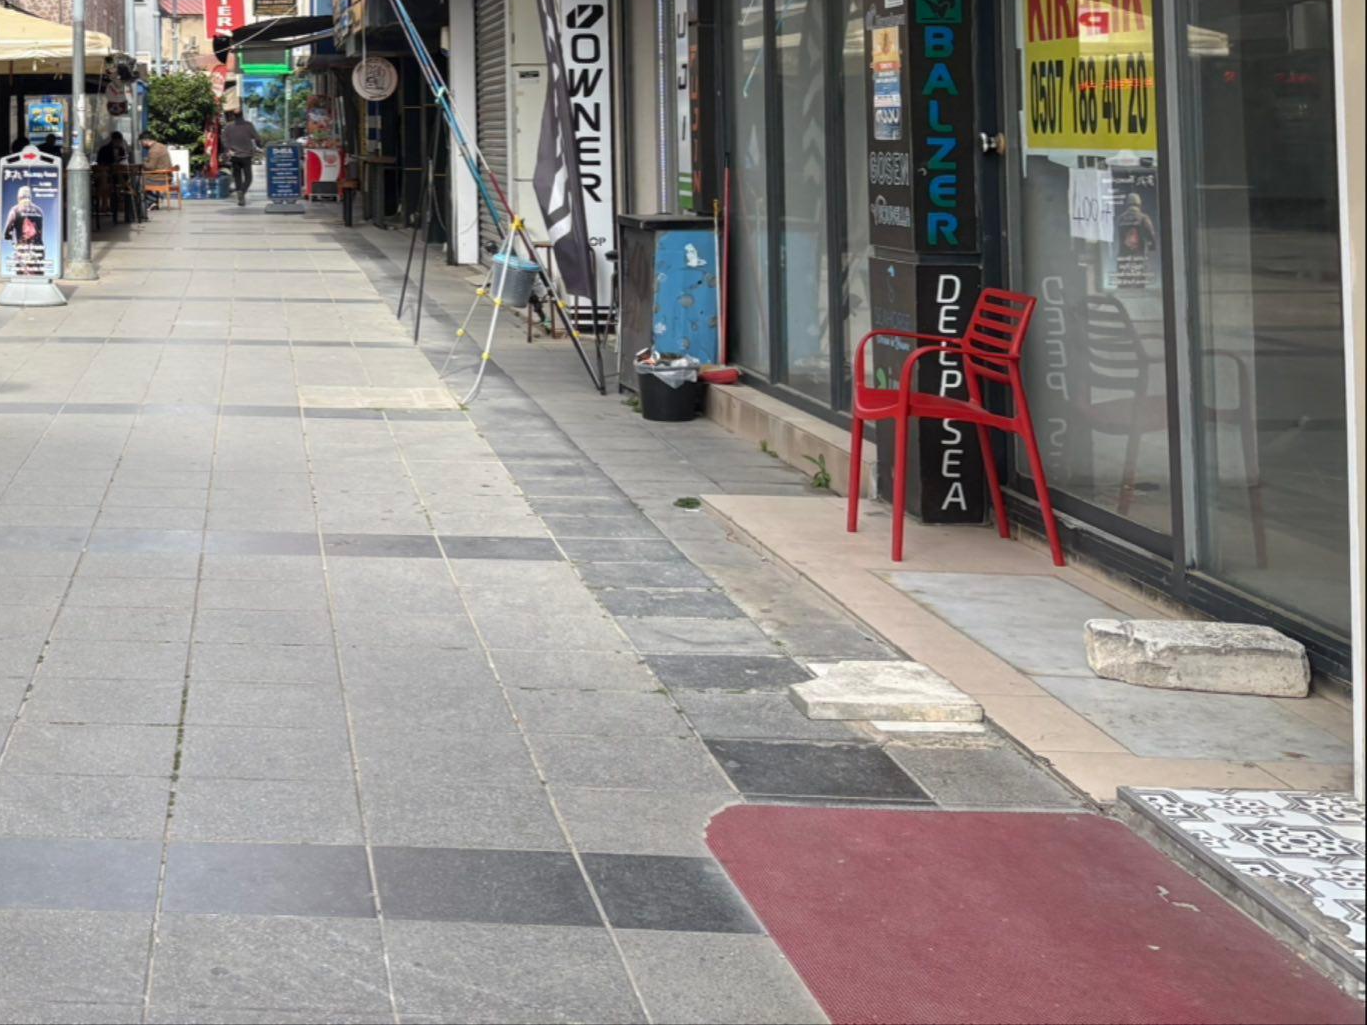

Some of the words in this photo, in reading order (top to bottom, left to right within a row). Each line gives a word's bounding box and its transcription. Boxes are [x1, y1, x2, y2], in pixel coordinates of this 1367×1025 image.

[568, 32, 604, 203] OWNER
[922, 26, 959, 246] BALZER
[1030, 59, 1064, 136] 0507
[940, 417, 968, 511] SEA
